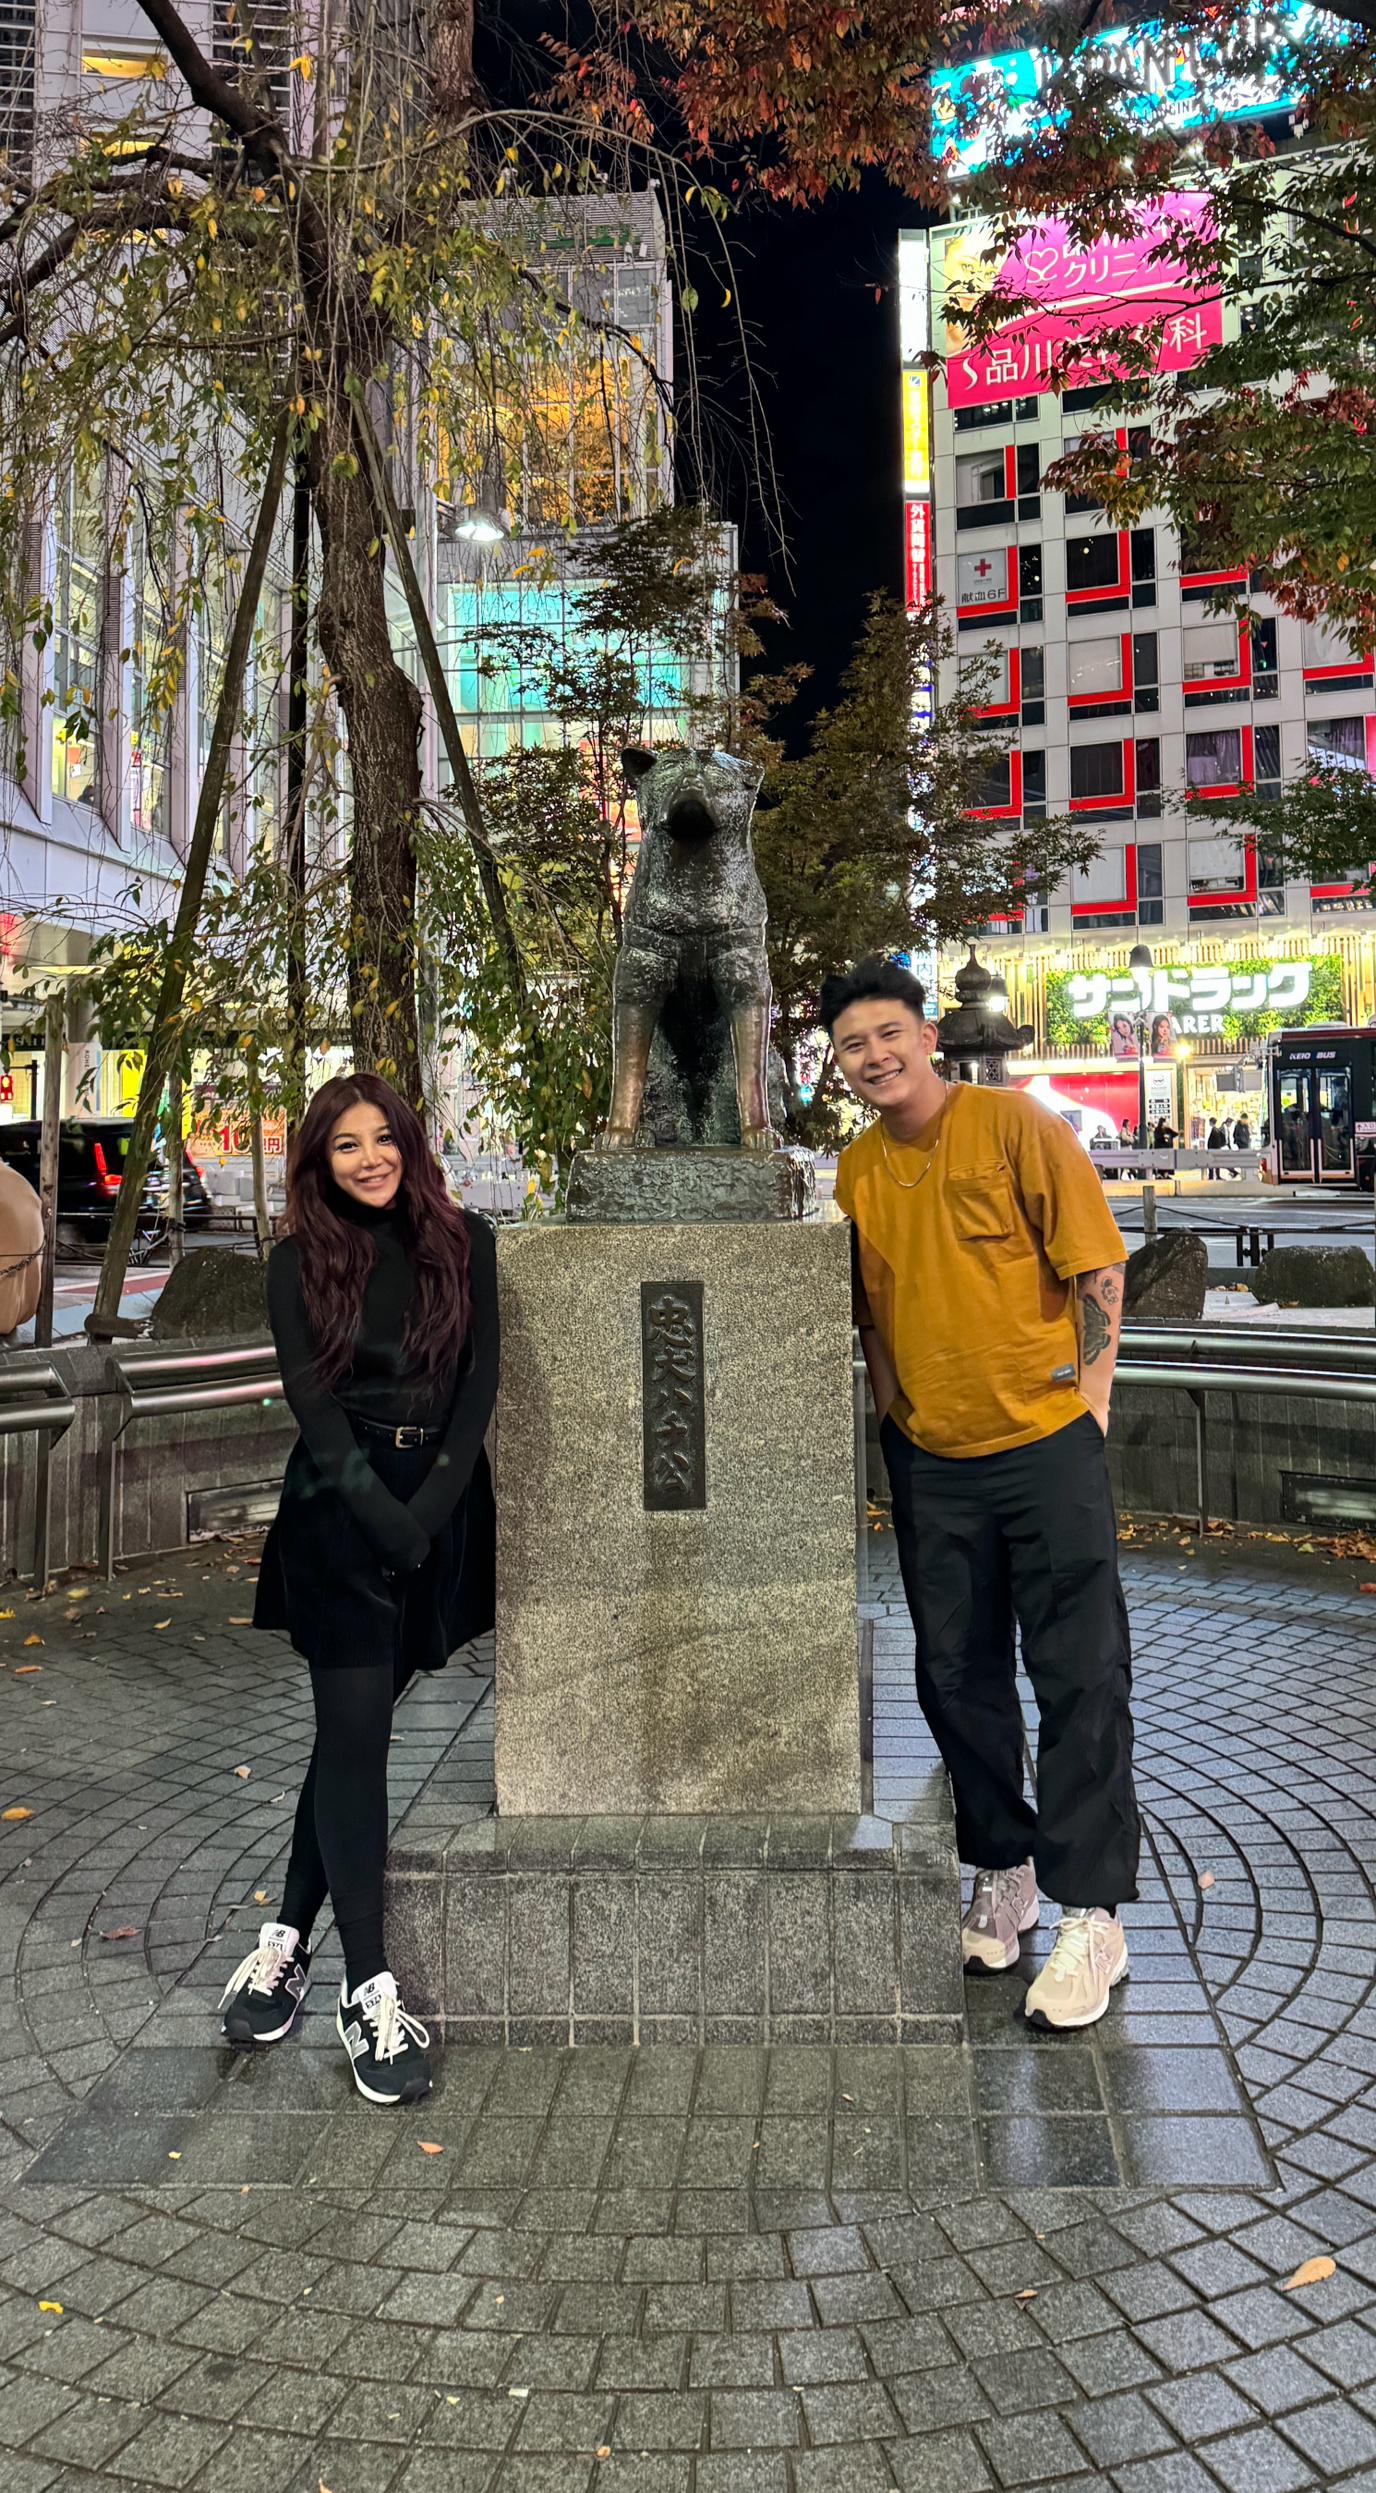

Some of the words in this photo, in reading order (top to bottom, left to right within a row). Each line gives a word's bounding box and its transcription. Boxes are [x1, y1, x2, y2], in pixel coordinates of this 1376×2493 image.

[1064, 251, 1183, 289] クリニ
[985, 311, 1208, 386] 品川科
[1068, 961, 1313, 1018] サンドラッグ
[1171, 1014, 1225, 1034] ARER
[1290, 1052, 1311, 1060] KEIO
[1316, 1051, 1336, 1059] BUS
[648, 1296, 697, 1493] 忠犬ハチ公
